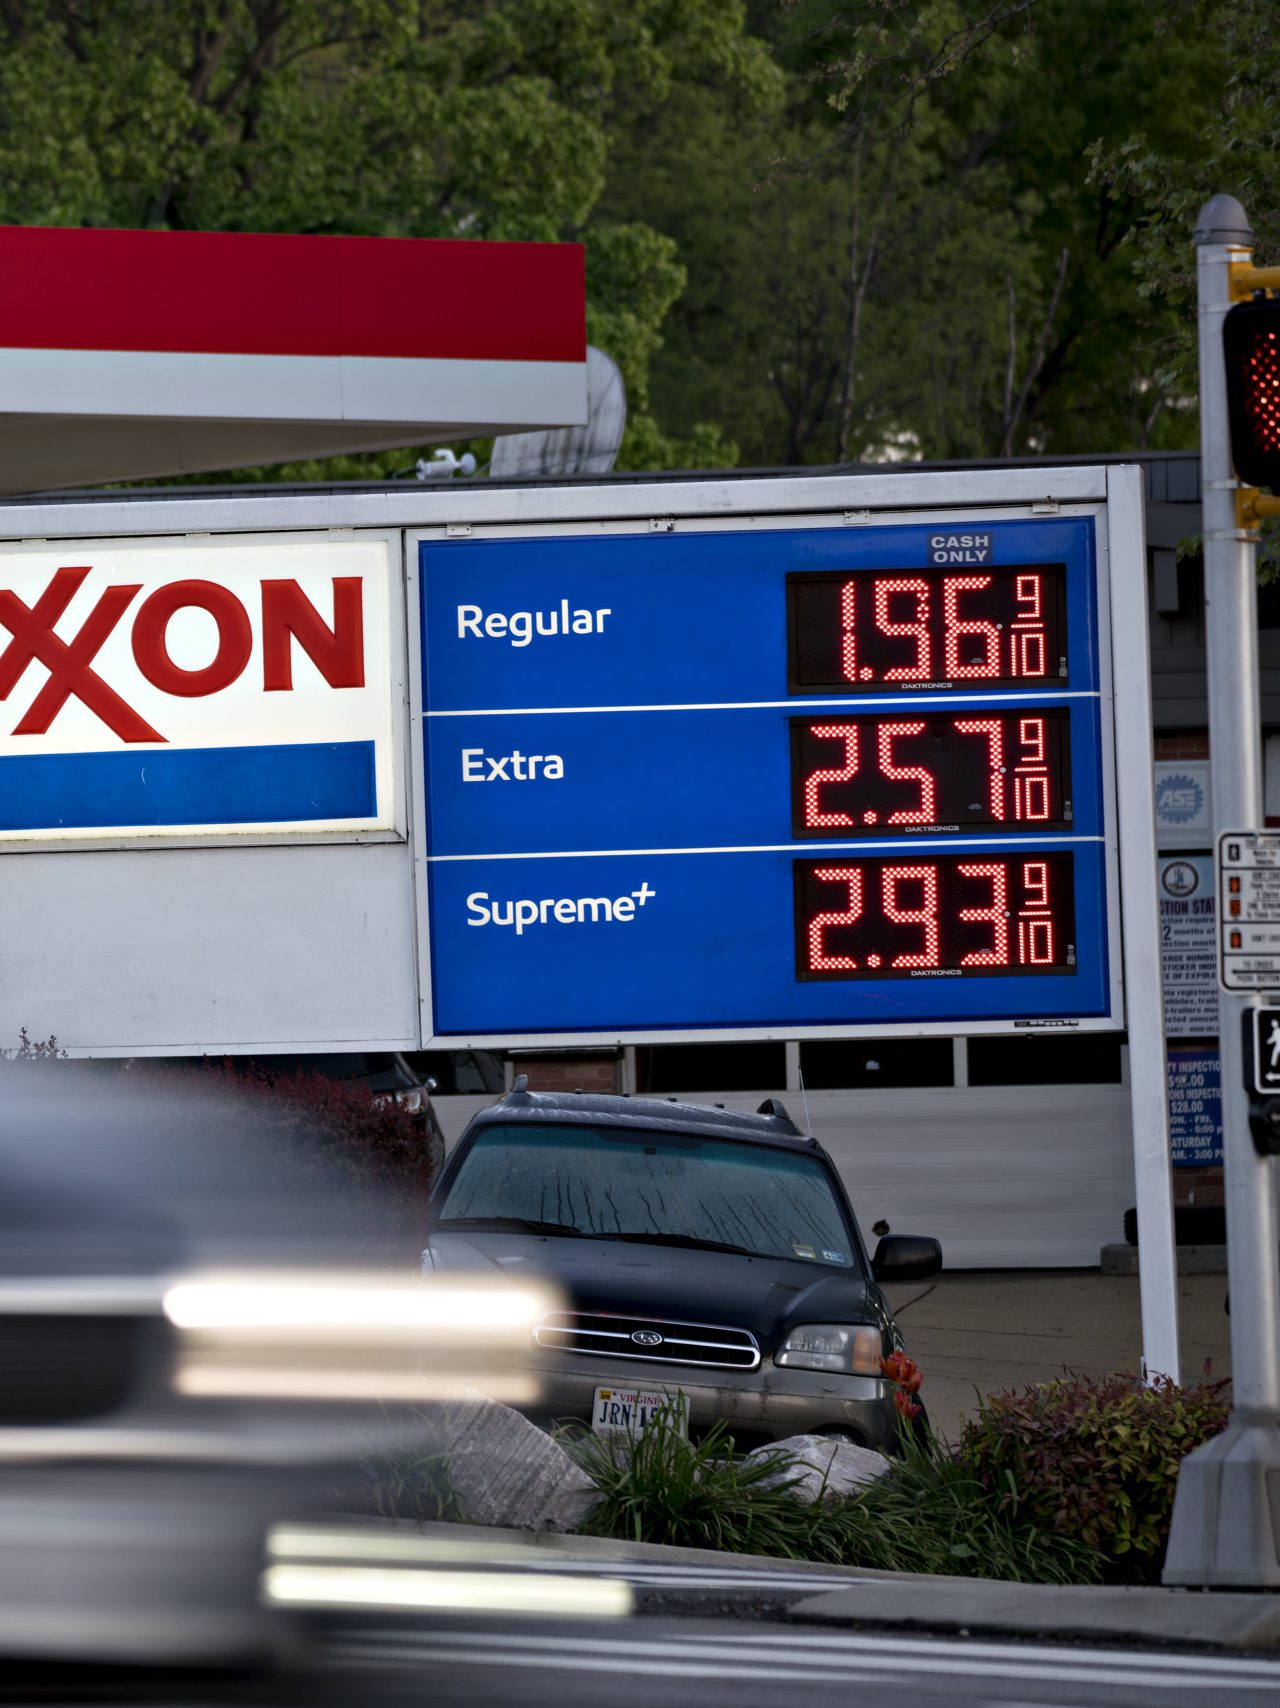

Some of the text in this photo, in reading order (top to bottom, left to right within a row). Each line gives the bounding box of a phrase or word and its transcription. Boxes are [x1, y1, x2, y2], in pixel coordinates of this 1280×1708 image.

[931, 535, 989, 549] CASH
[933, 550, 988, 563] ONLY
[457, 599, 612, 647] Regular
[461, 748, 564, 782] Extra
[805, 719, 1003, 827] 2.57
[1159, 790, 1195, 806] ASE
[809, 864, 1008, 969] 2.93
[1171, 1101, 1203, 1113] $28.00
[1194, 1115, 1212, 1124] FRI.
[1172, 1136, 1212, 1148] ATURDAY
[1194, 1149, 1213, 1159] 3:00
[620, 1393, 664, 1406] VIRGINIA
